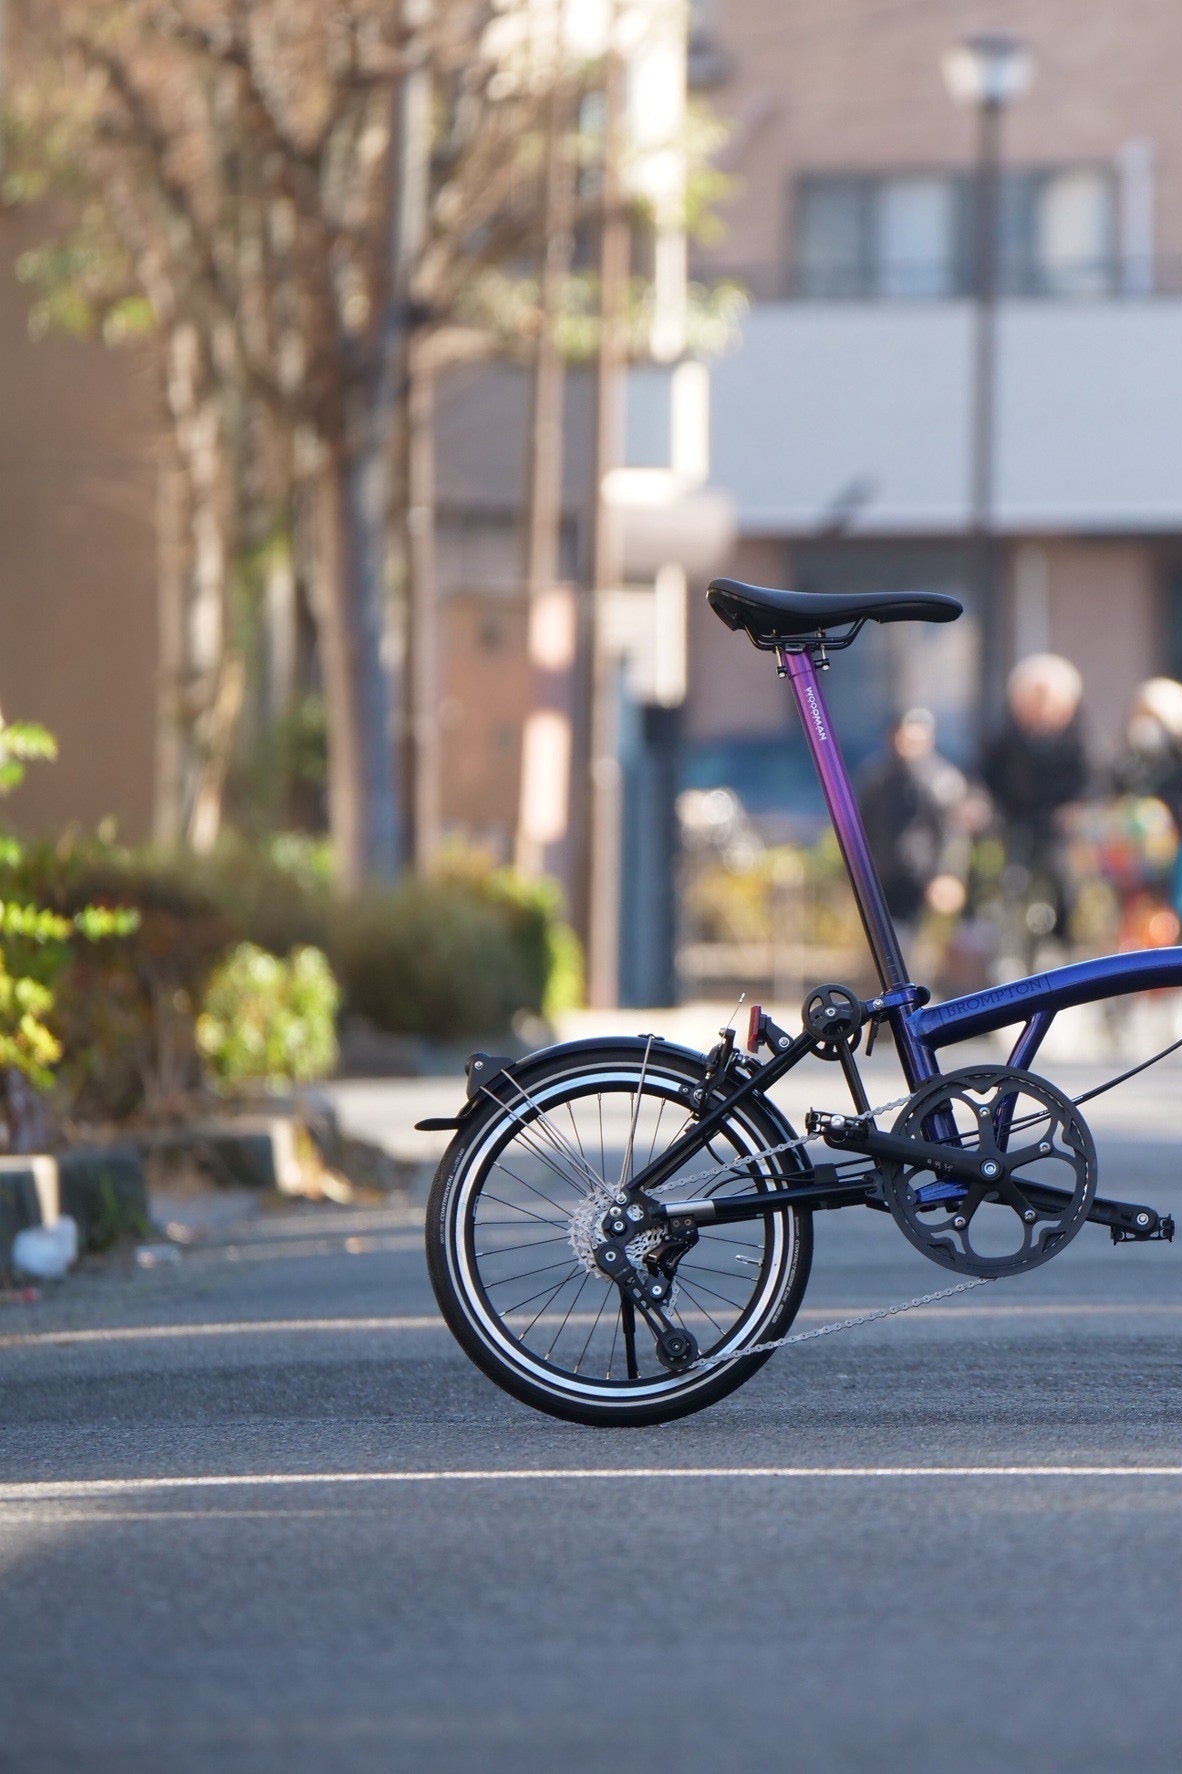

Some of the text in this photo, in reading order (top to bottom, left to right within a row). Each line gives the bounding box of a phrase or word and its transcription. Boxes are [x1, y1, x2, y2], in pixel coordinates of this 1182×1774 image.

[806, 686, 827, 741] WOODMAN
[945, 977, 1042, 1018] BROMPTON
[439, 1174, 454, 1222] CONTINENTAL
